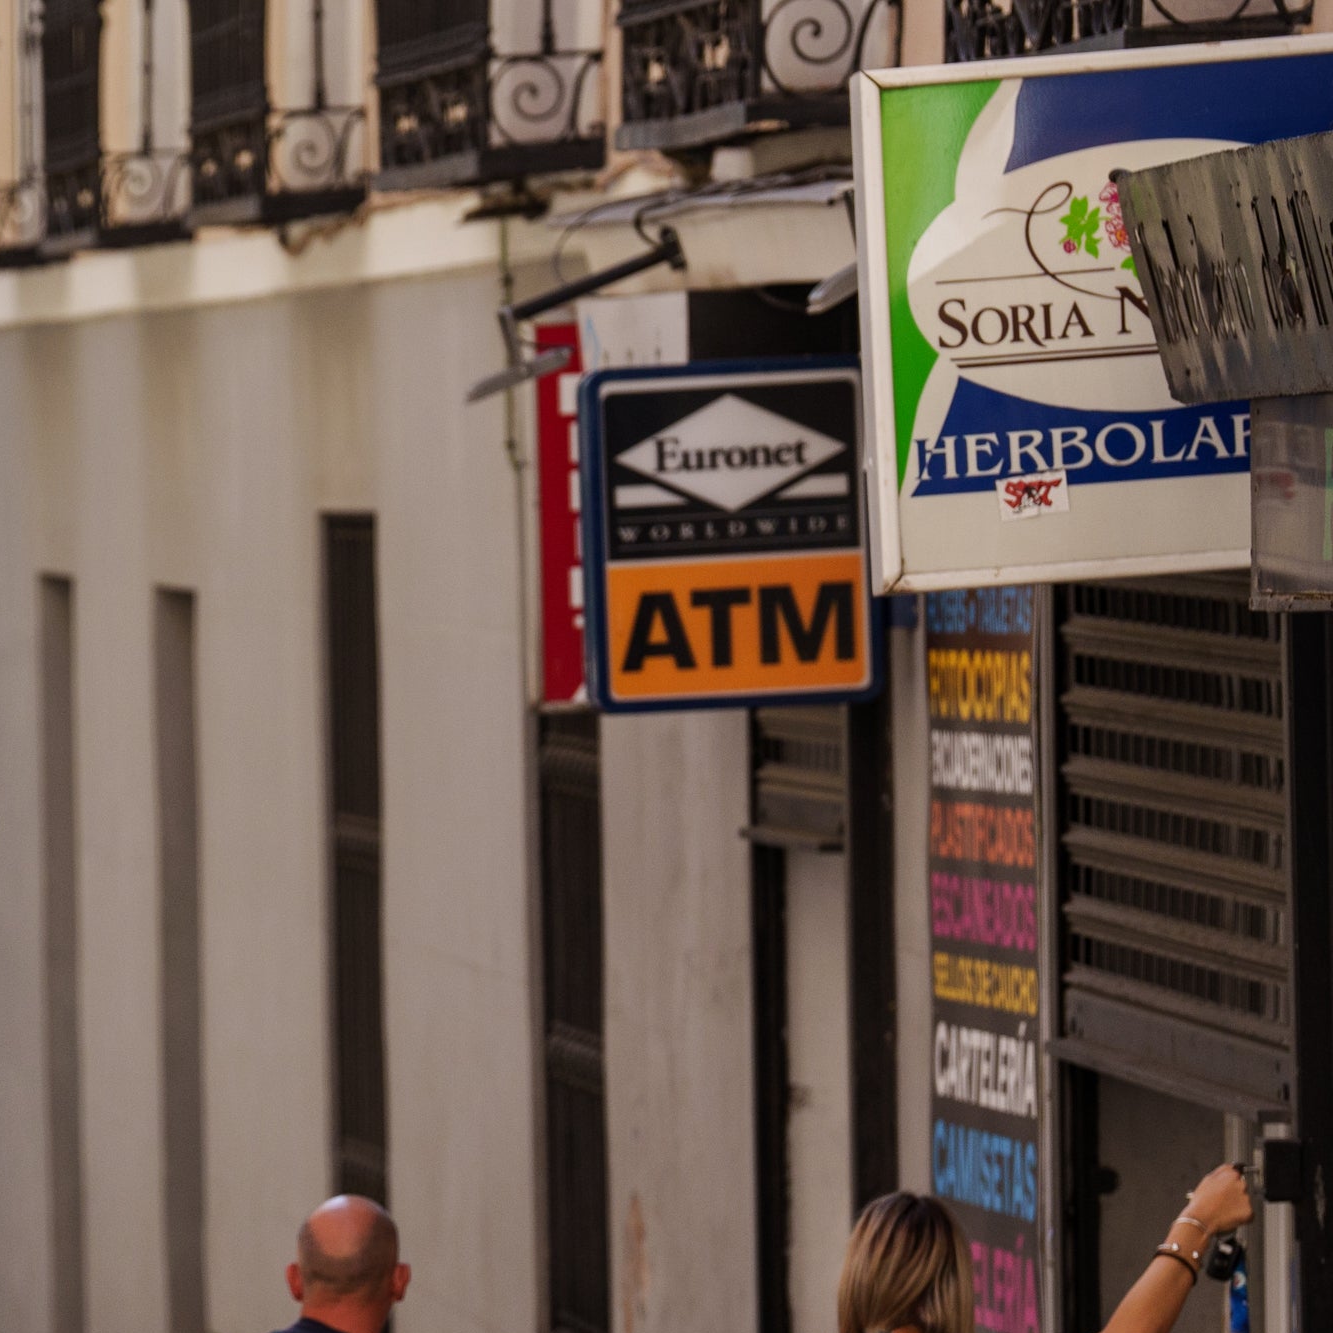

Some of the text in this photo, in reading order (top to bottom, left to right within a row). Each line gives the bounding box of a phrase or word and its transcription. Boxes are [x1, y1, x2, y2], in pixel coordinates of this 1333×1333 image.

[938, 298, 1095, 349] SORIA
[654, 436, 807, 473] Euronet
[618, 514, 851, 543] WORLDWIDE
[621, 580, 857, 672] ATM
[928, 649, 1032, 724] FOTOCOPIAS
[931, 799, 1035, 868] PLASTIFICADOS
[932, 871, 1037, 951] ESCANEADOS
[935, 1020, 1038, 1119] CARTELERÍA
[934, 1118, 1037, 1223] CAMISETAS
